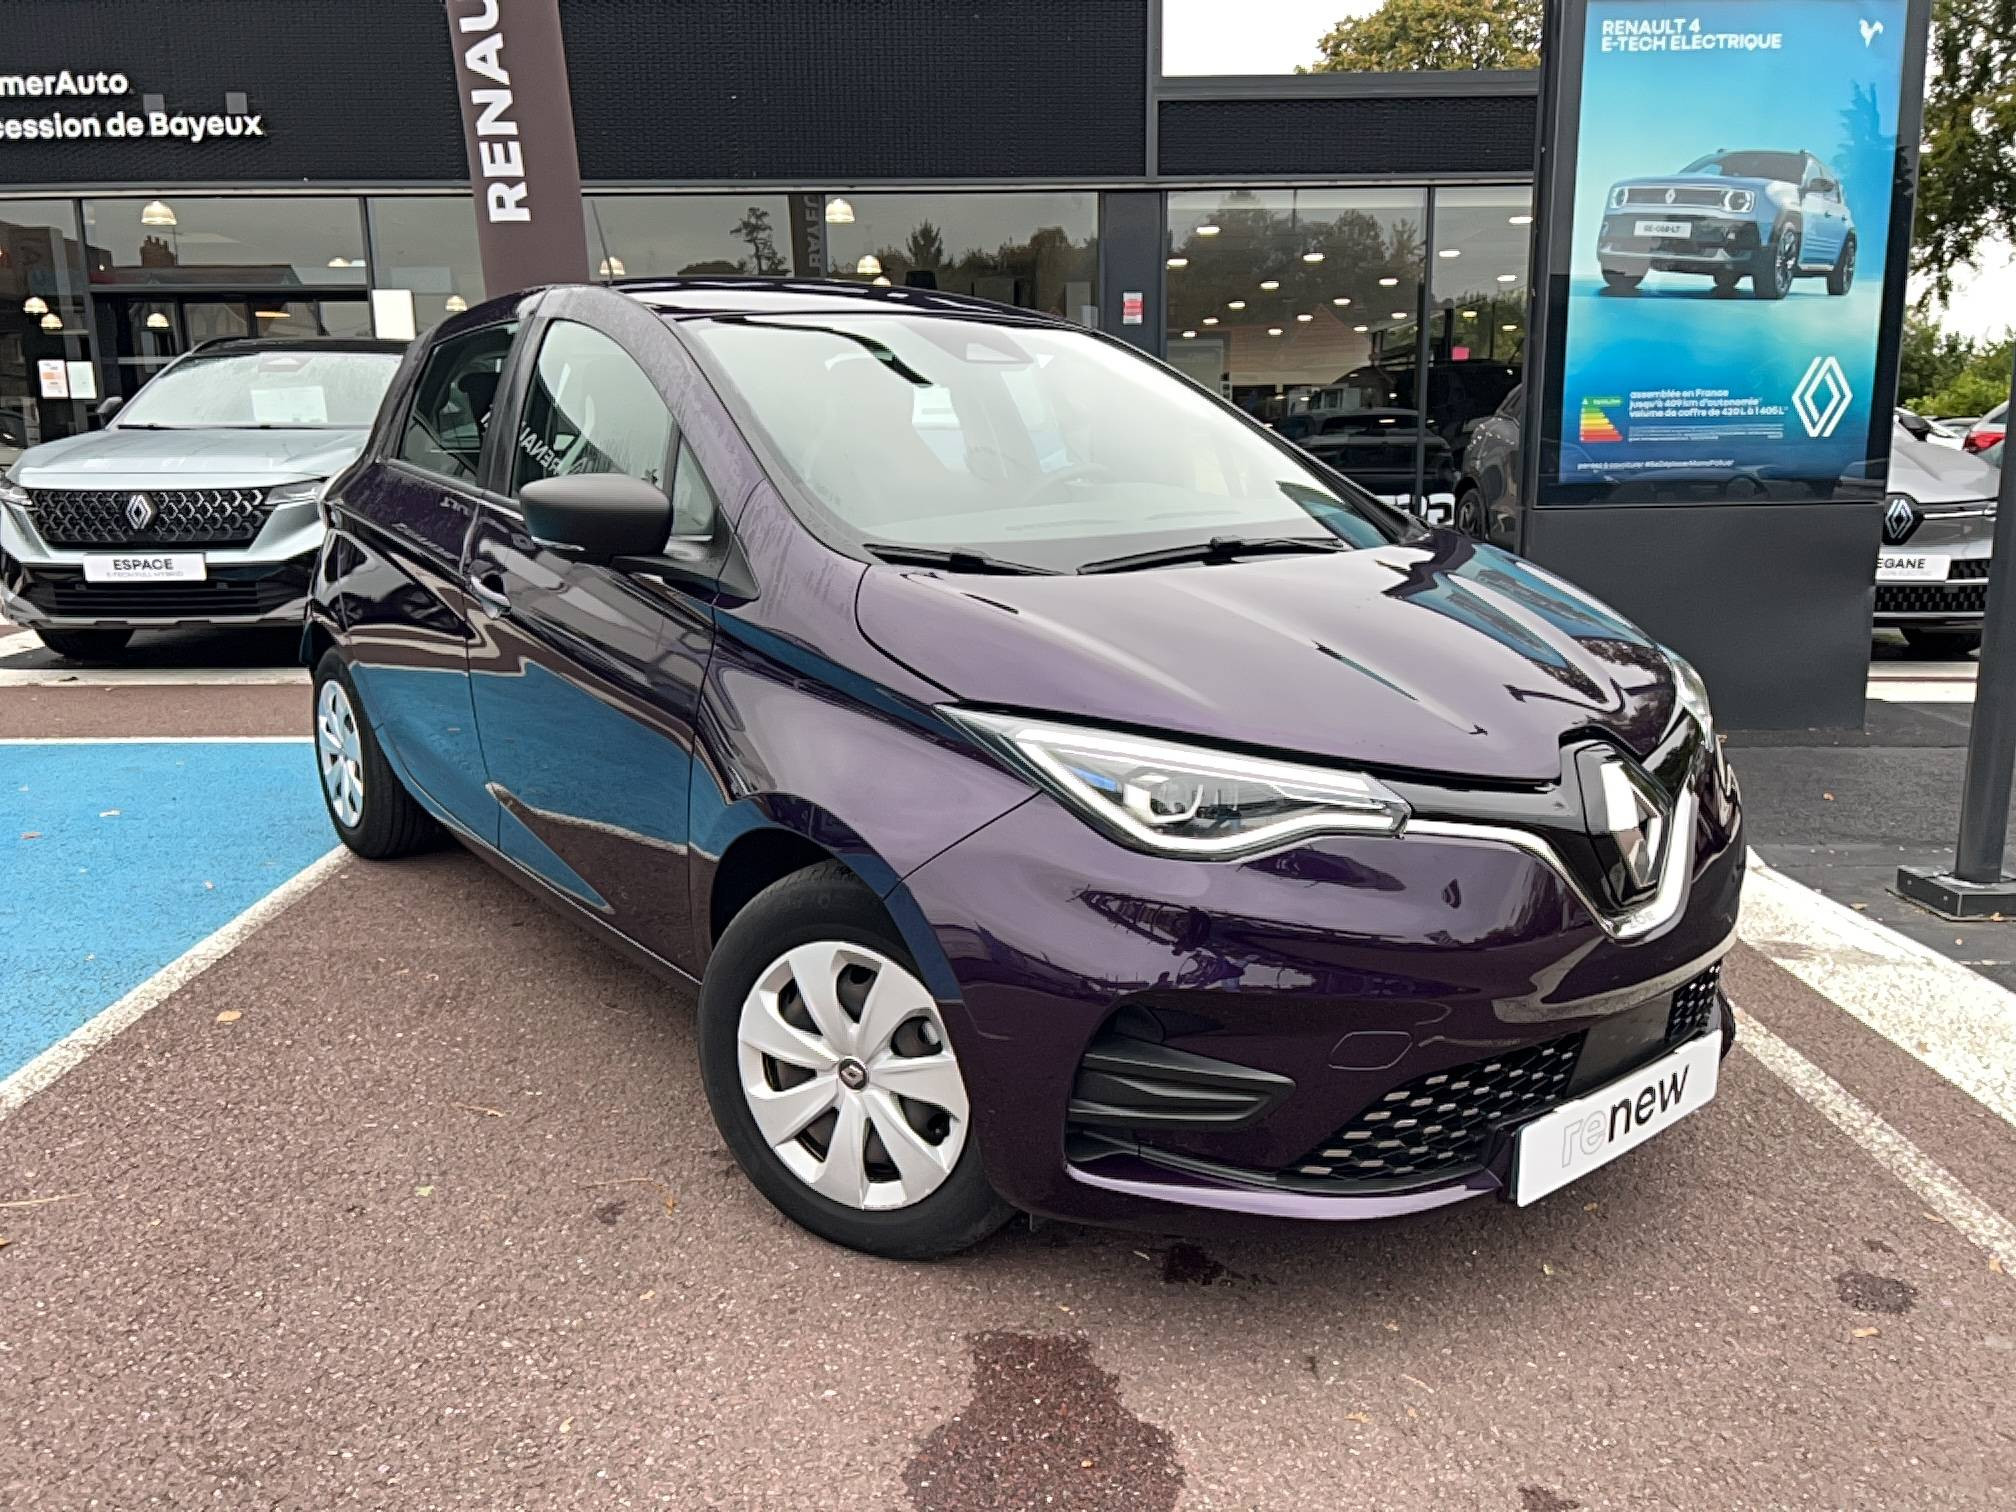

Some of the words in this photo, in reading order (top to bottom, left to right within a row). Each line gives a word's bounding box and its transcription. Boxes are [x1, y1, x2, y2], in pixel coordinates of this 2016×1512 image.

[1602, 19, 1686, 36] RENAULT
[1688, 17, 1702, 33] 4
[1601, 35, 1667, 52] E-TECH
[1671, 33, 1783, 51] ELECTRIQUE
[0, 71, 129, 96] merAuto
[459, 0, 531, 223] RENAU
[0, 112, 102, 139] ession
[106, 111, 144, 137] de
[149, 112, 264, 142] Bayeux
[1682, 390, 1695, 398] en
[1696, 388, 1729, 397] France
[112, 559, 173, 570] ESPACE
[1562, 1064, 1689, 1168] renew
